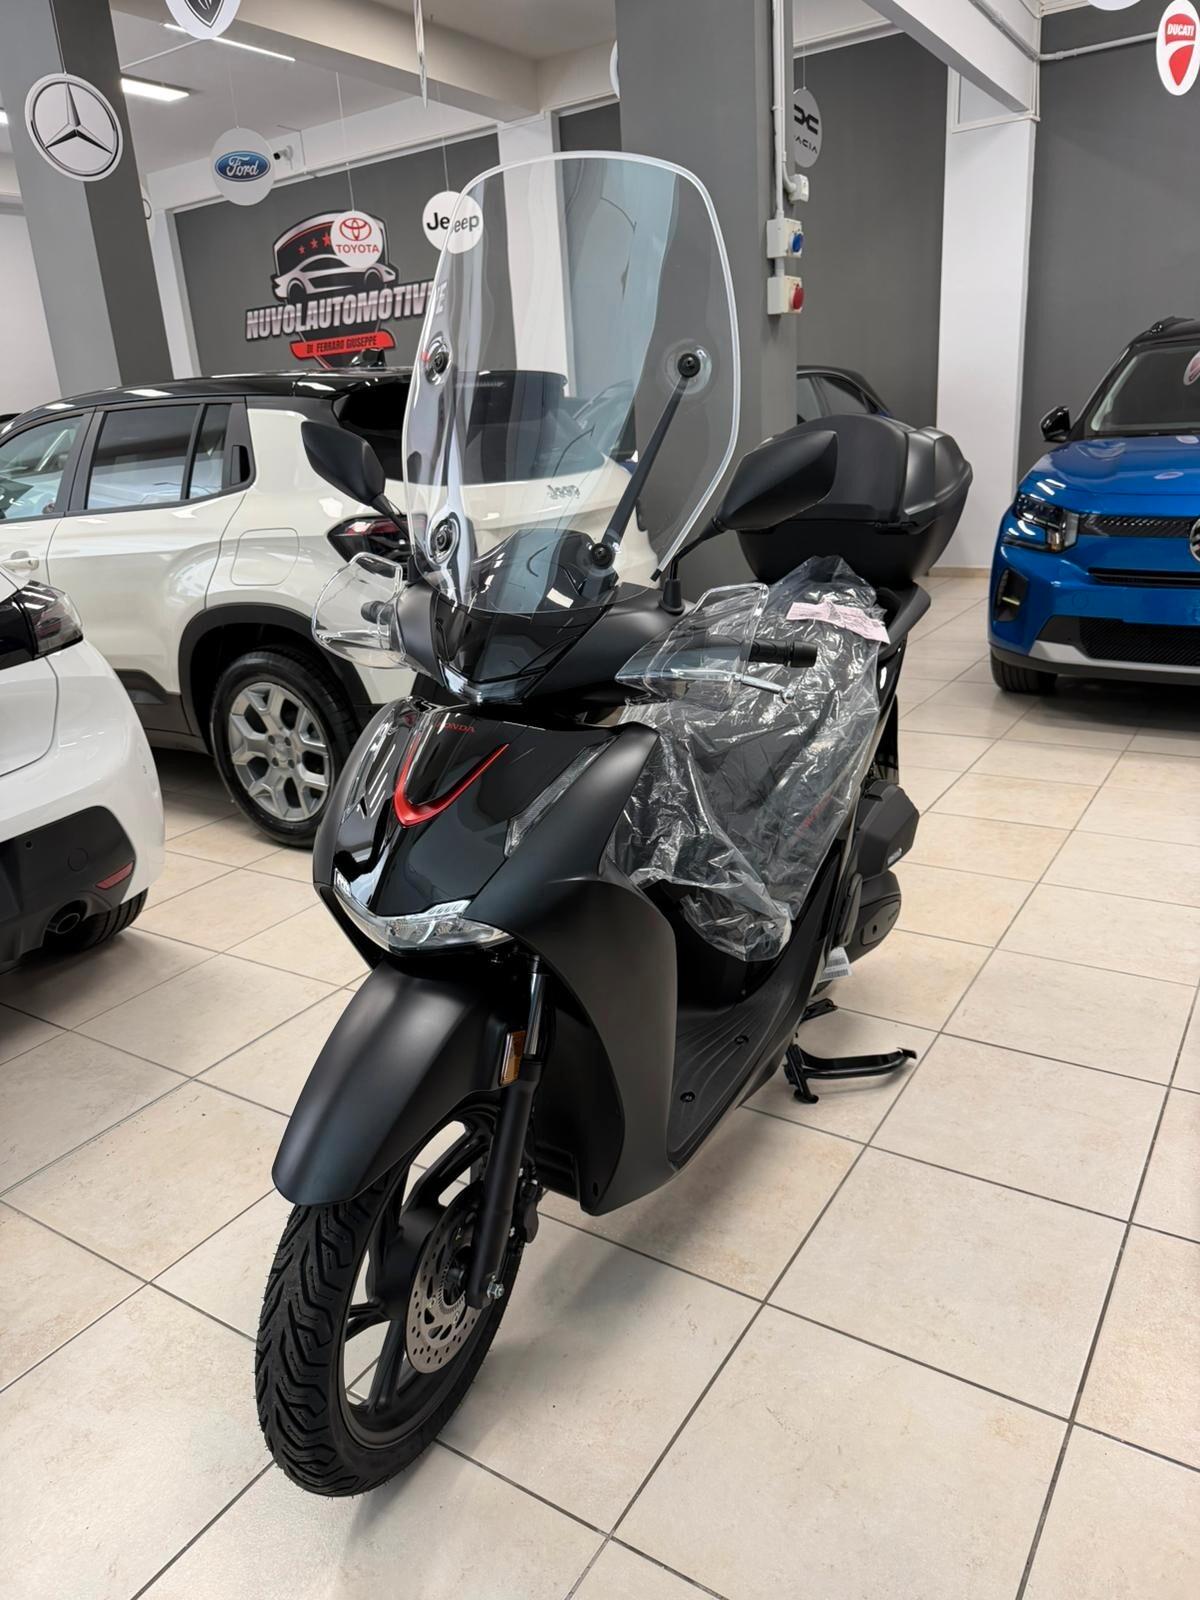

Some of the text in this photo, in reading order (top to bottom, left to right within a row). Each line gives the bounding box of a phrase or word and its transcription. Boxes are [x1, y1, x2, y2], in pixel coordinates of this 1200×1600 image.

[1167, 23, 1195, 36] DUCATI
[794, 135, 818, 154] ACIA
[226, 156, 260, 176] Ford
[335, 243, 380, 254] TOYOTA
[306, 335, 377, 354] DI FERRARO GIUSEPPE
